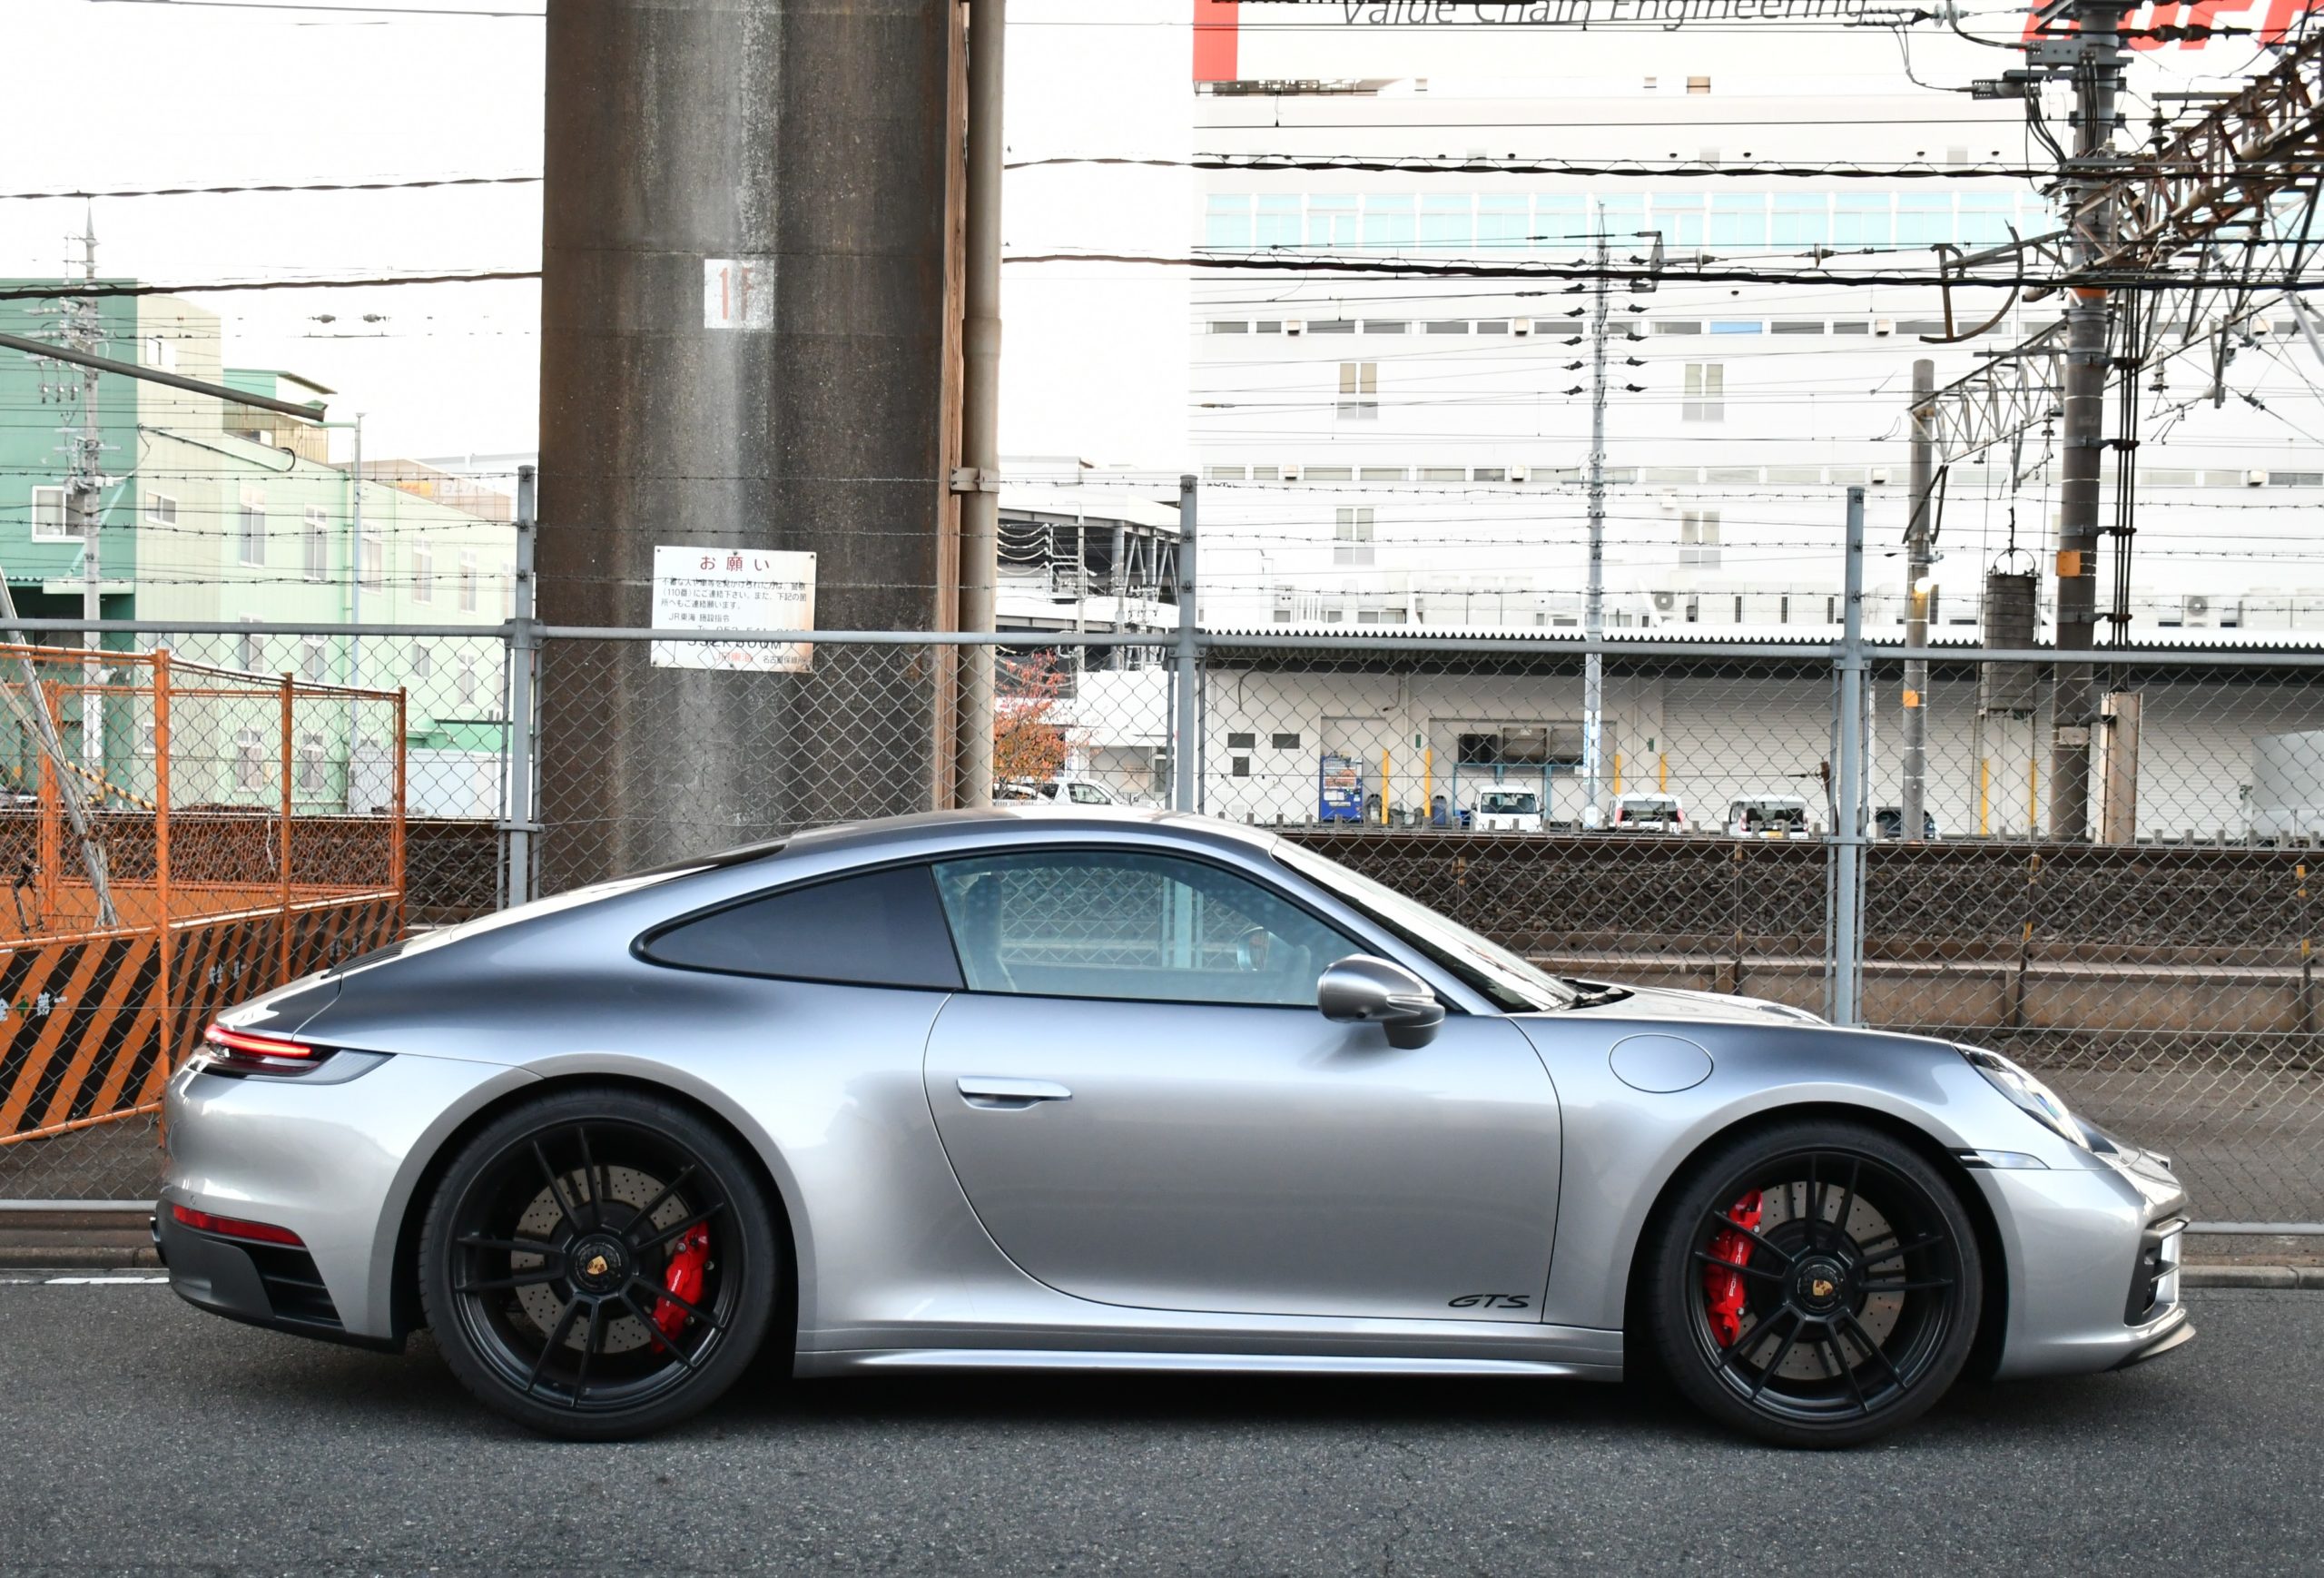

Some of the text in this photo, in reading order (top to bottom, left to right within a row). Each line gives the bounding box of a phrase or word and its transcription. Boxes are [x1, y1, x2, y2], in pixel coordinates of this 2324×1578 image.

[700, 556, 770, 572] お願い
[1728, 1241, 1744, 1297] PORCHE
[1447, 1294, 1531, 1308] GTS
